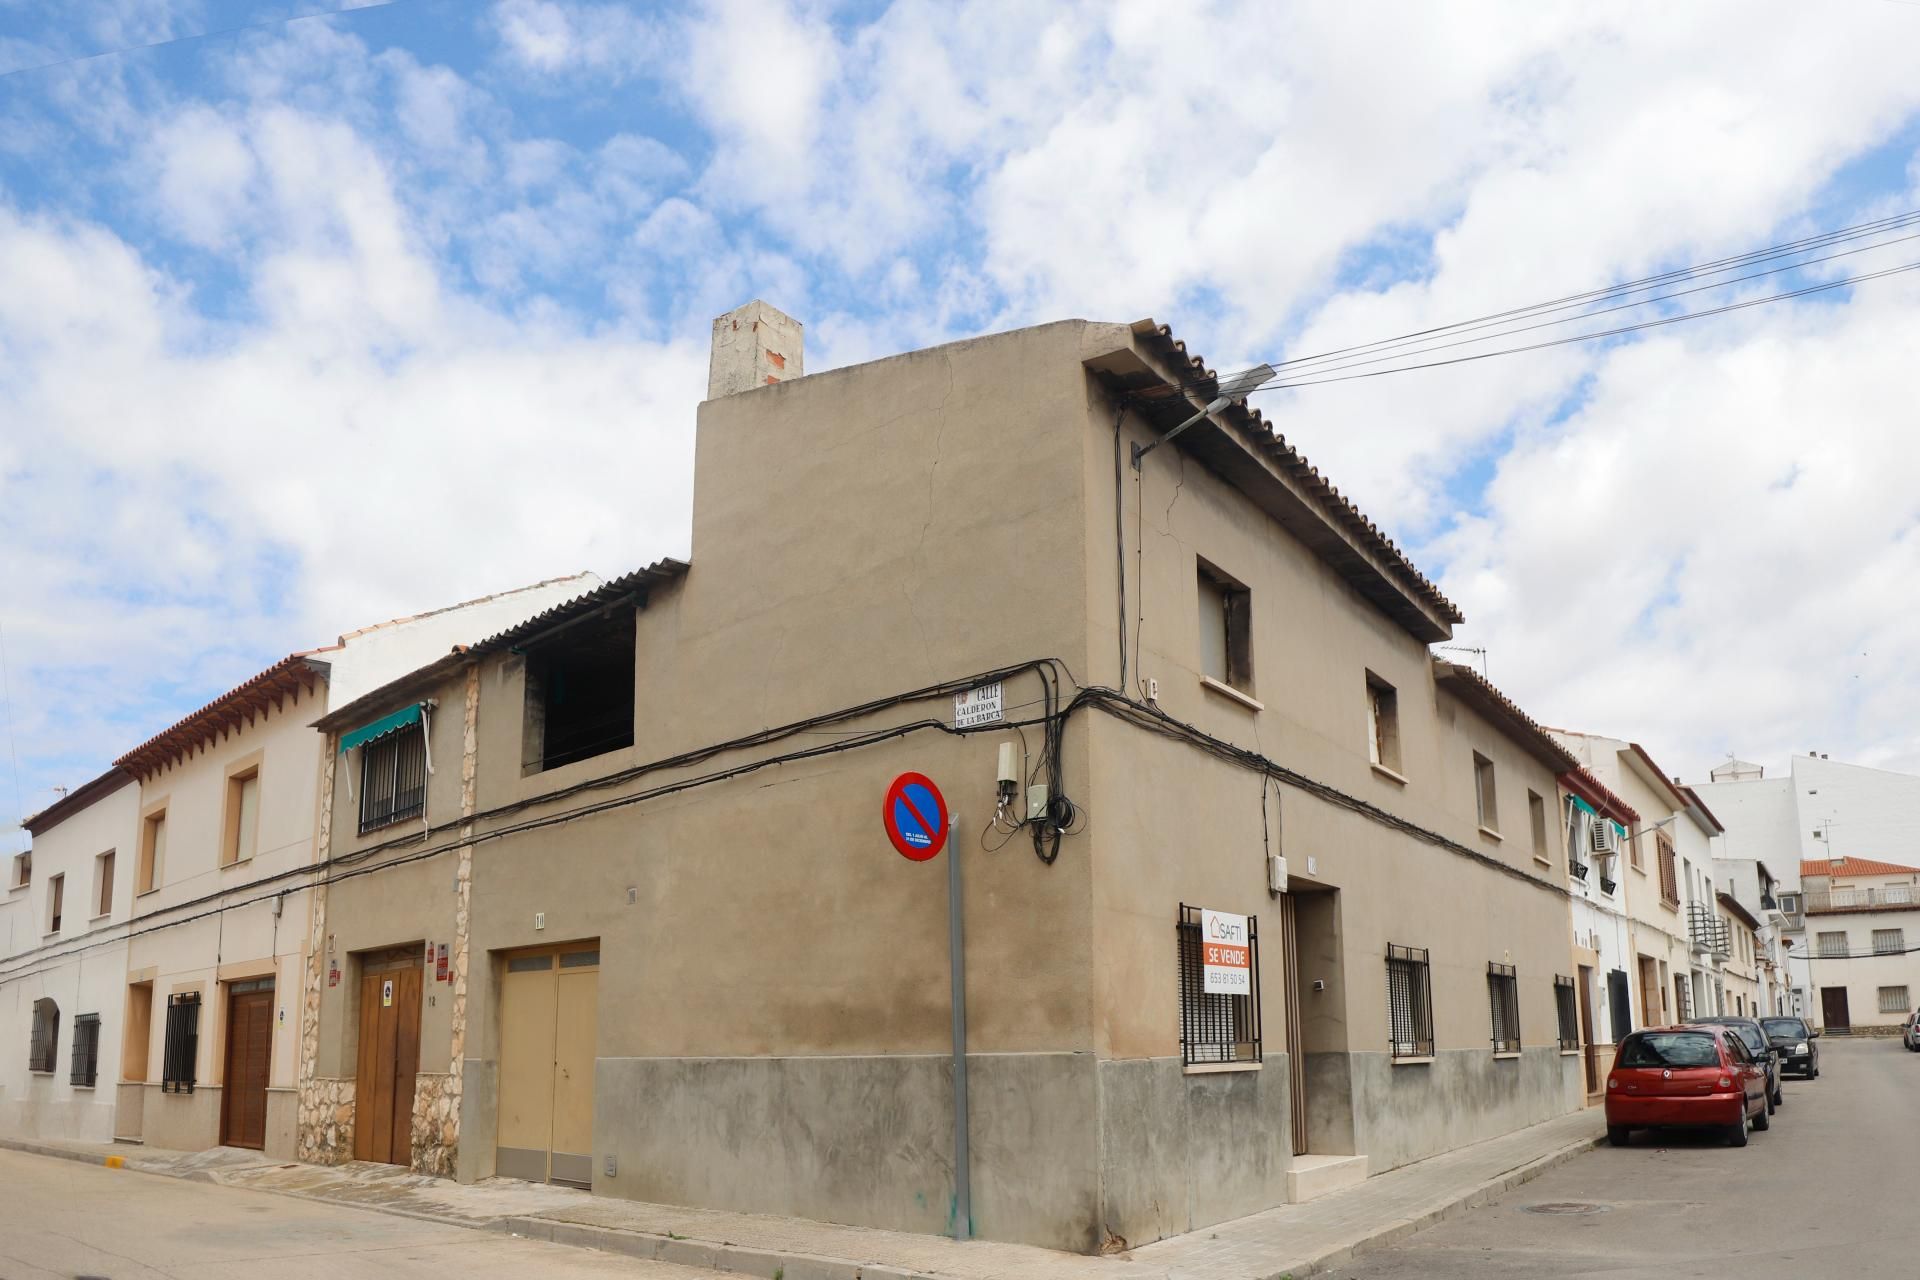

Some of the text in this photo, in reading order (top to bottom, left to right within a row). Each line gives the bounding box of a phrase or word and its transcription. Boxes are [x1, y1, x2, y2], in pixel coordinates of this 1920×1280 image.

[977, 684, 999, 701] CALLE
[957, 702, 996, 717] CALDERON
[967, 717, 975, 725] LA
[976, 711, 1000, 722] BARCA
[1209, 947, 1245, 965] SE VENDE
